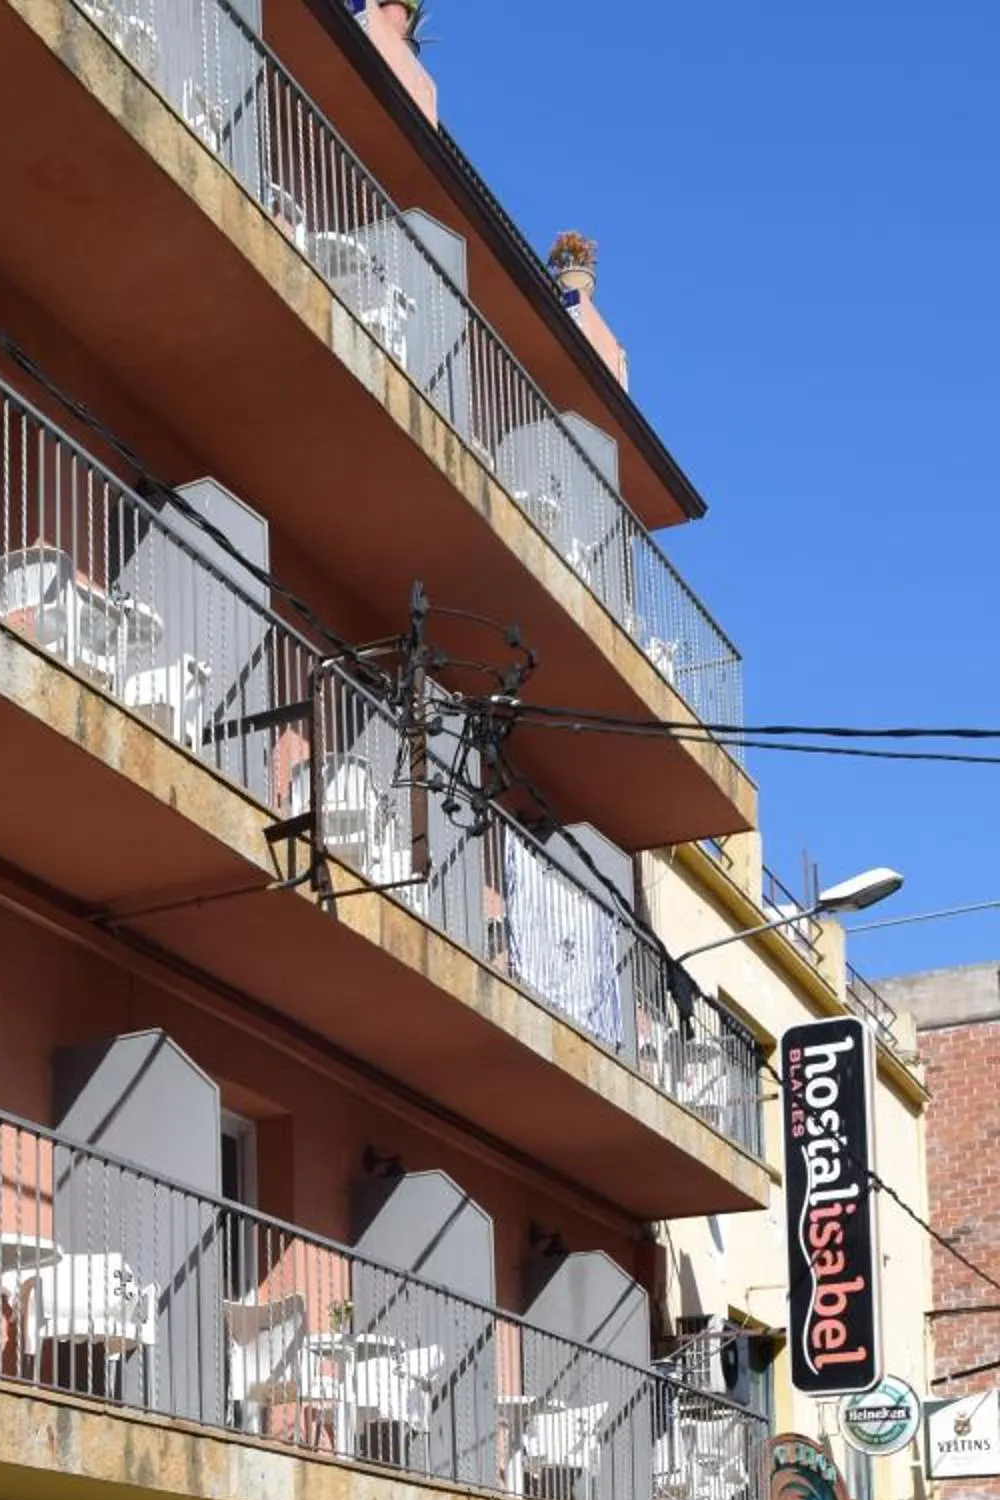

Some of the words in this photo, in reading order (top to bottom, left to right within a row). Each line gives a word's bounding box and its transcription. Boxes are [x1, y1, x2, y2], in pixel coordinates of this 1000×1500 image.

[805, 1036, 860, 1206] hostal
[808, 1205, 866, 1370] isabel
[849, 1407, 907, 1420] Heineken
[937, 1439, 991, 1453] VELTINS
